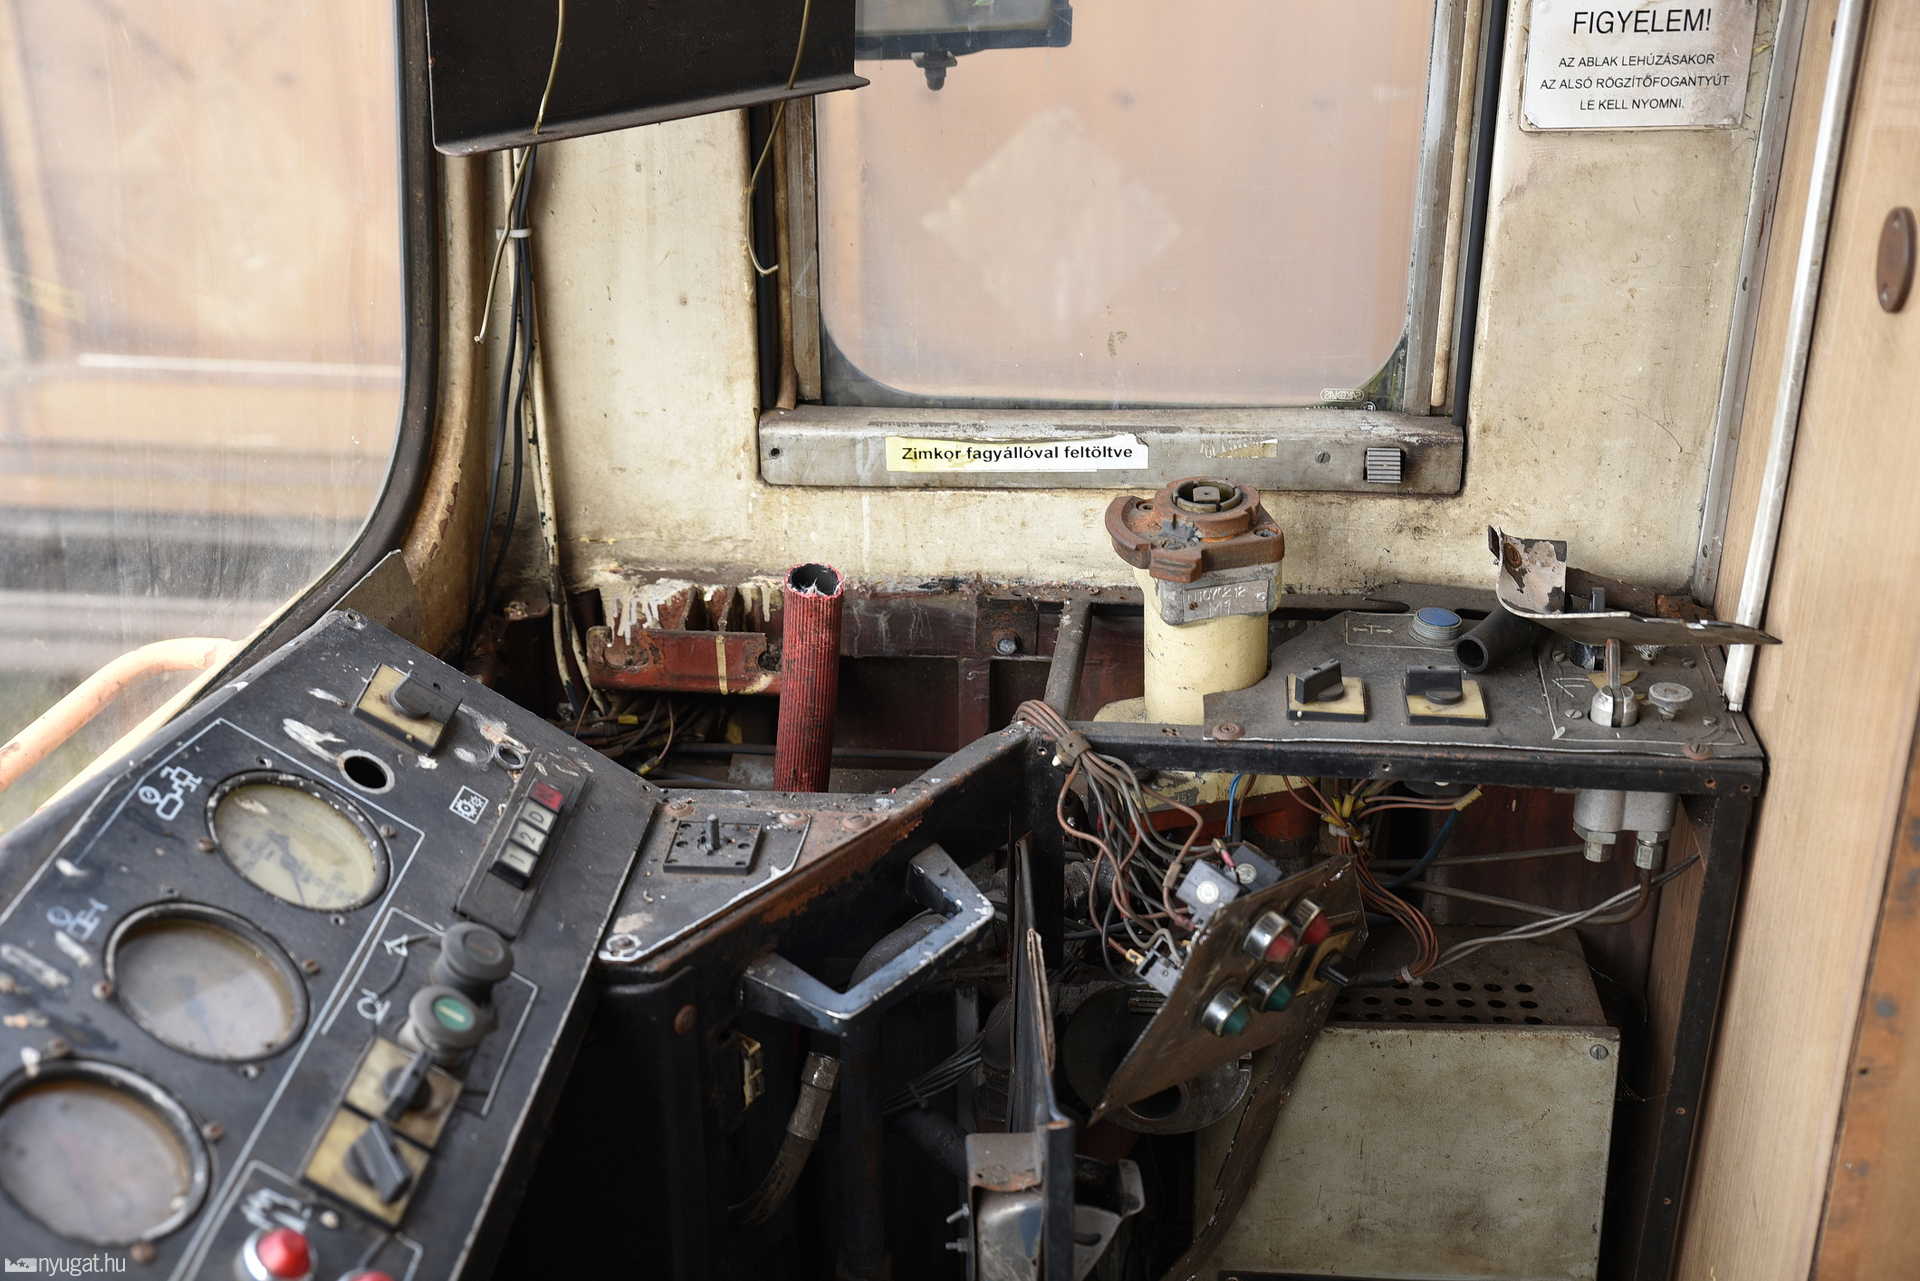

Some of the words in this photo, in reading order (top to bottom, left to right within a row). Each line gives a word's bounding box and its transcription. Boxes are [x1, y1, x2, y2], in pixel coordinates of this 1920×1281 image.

[1572, 8, 1712, 35] FIGYELEM!
[1558, 56, 1575, 68] AZ
[1577, 54, 1619, 67] ABLAK
[1621, 52, 1715, 67] LEHÚZÁSAKOR
[1540, 79, 1556, 90] AZ
[1559, 76, 1593, 89] ALSÓ
[1596, 74, 1730, 89] RÖGZÍTŐFOGANTYÚT
[1579, 99, 1596, 111] LE
[1598, 98, 1628, 110] KELL
[1631, 98, 1685, 110] NYOMNI.
[901, 446, 962, 461] Zimkor
[966, 445, 1059, 462] fagyállóval
[1064, 445, 1133, 459] feltöltve
